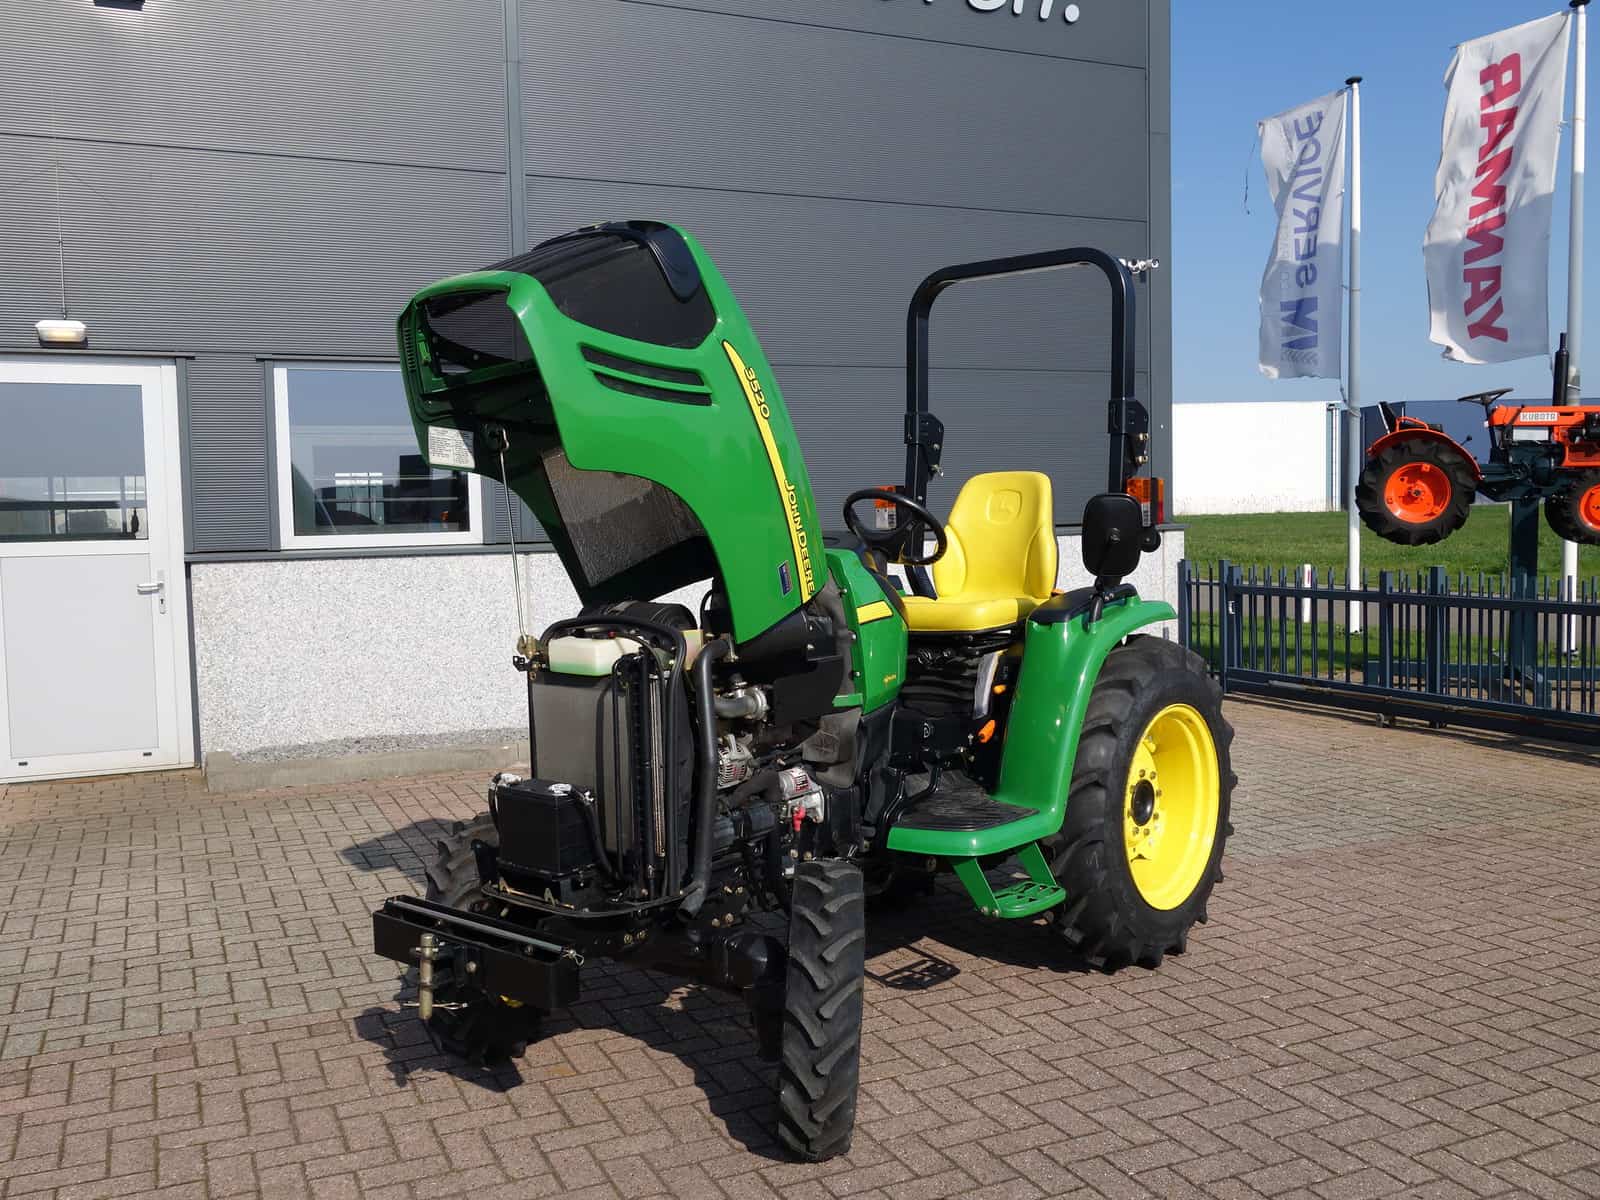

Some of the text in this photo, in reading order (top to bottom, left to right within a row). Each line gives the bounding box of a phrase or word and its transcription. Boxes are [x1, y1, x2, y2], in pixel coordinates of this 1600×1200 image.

[744, 367, 770, 419] 3520
[1521, 412, 1557, 421] KUBOTA
[784, 480, 815, 594] JOHN DEERE
